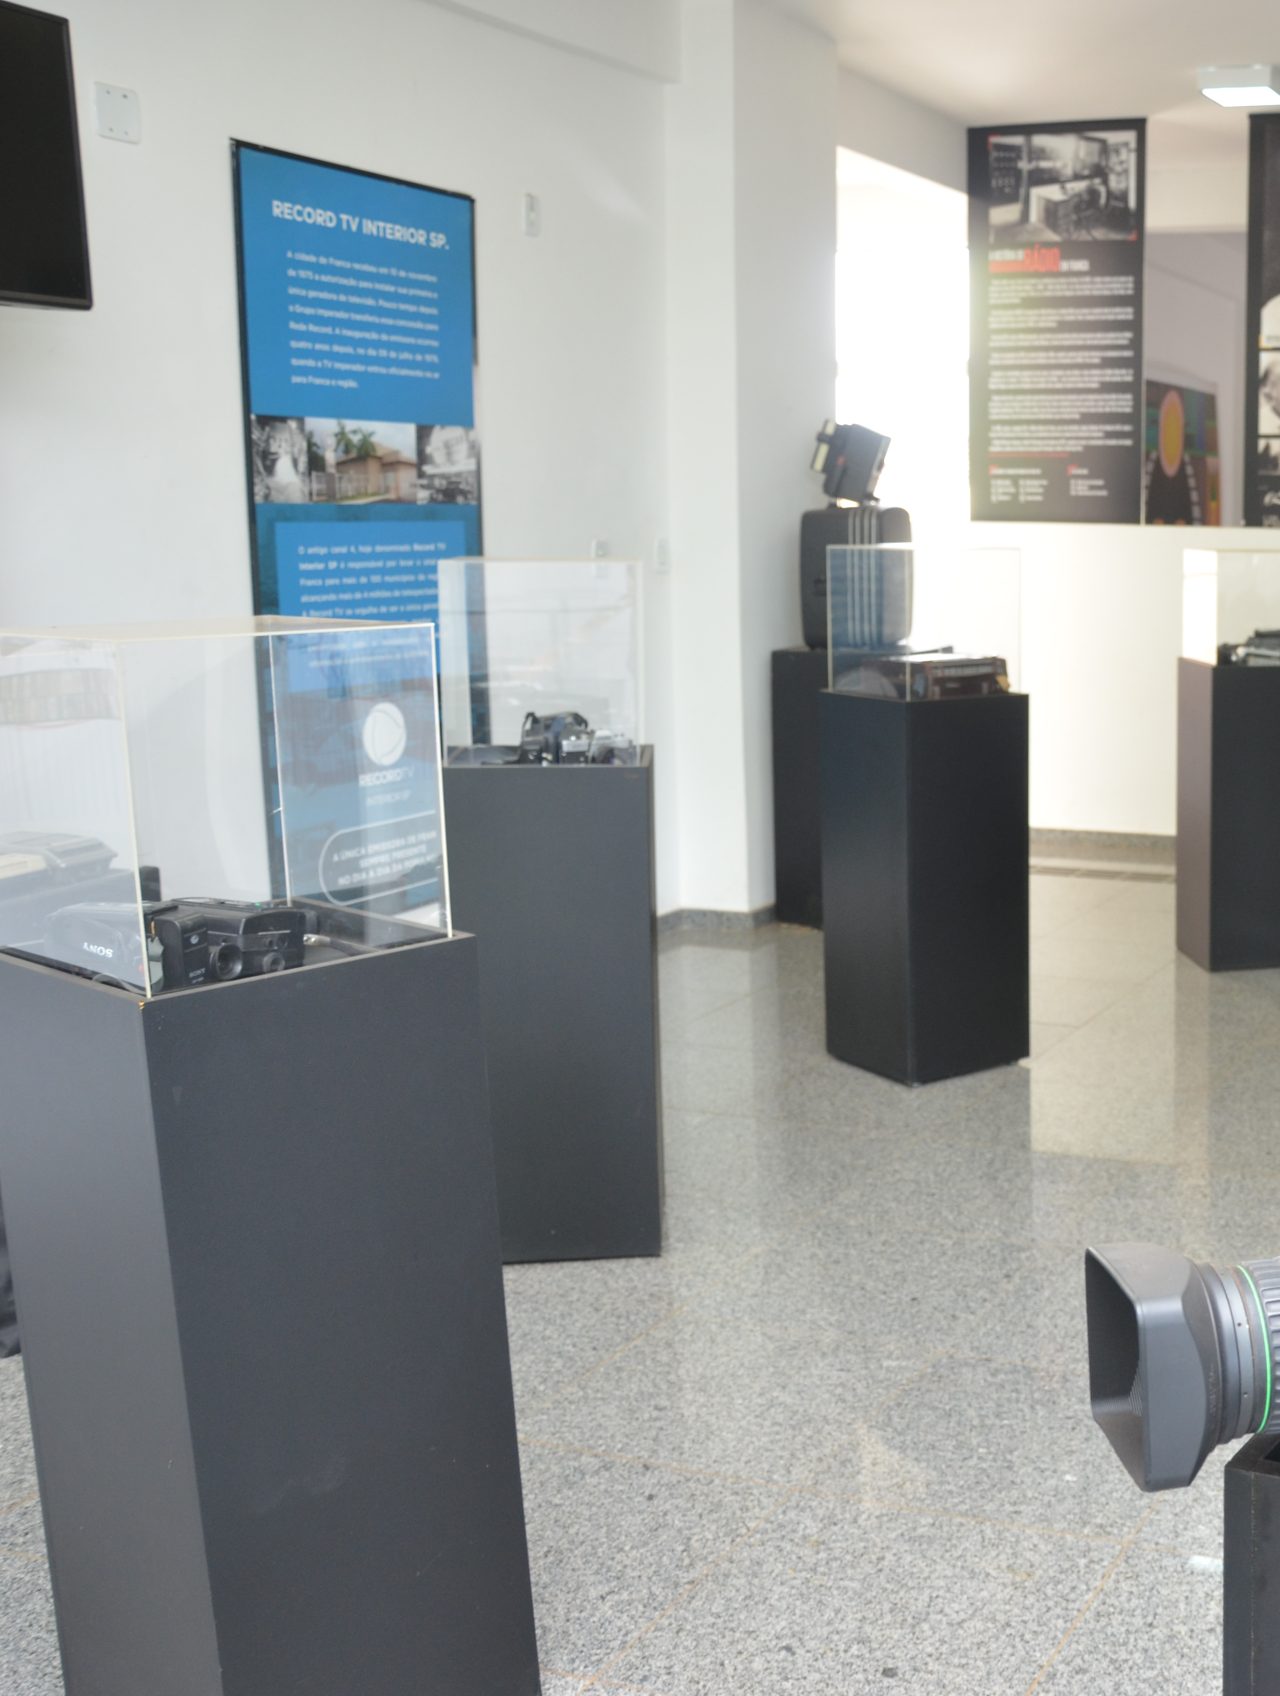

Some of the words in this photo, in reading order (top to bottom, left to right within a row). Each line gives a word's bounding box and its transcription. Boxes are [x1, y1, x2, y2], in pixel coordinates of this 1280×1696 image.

[272, 200, 337, 229] RECORD
[340, 213, 359, 232] TV
[362, 219, 427, 247] INTERIOR
[429, 231, 449, 250] SP.
[83, 942, 114, 958] SONY
